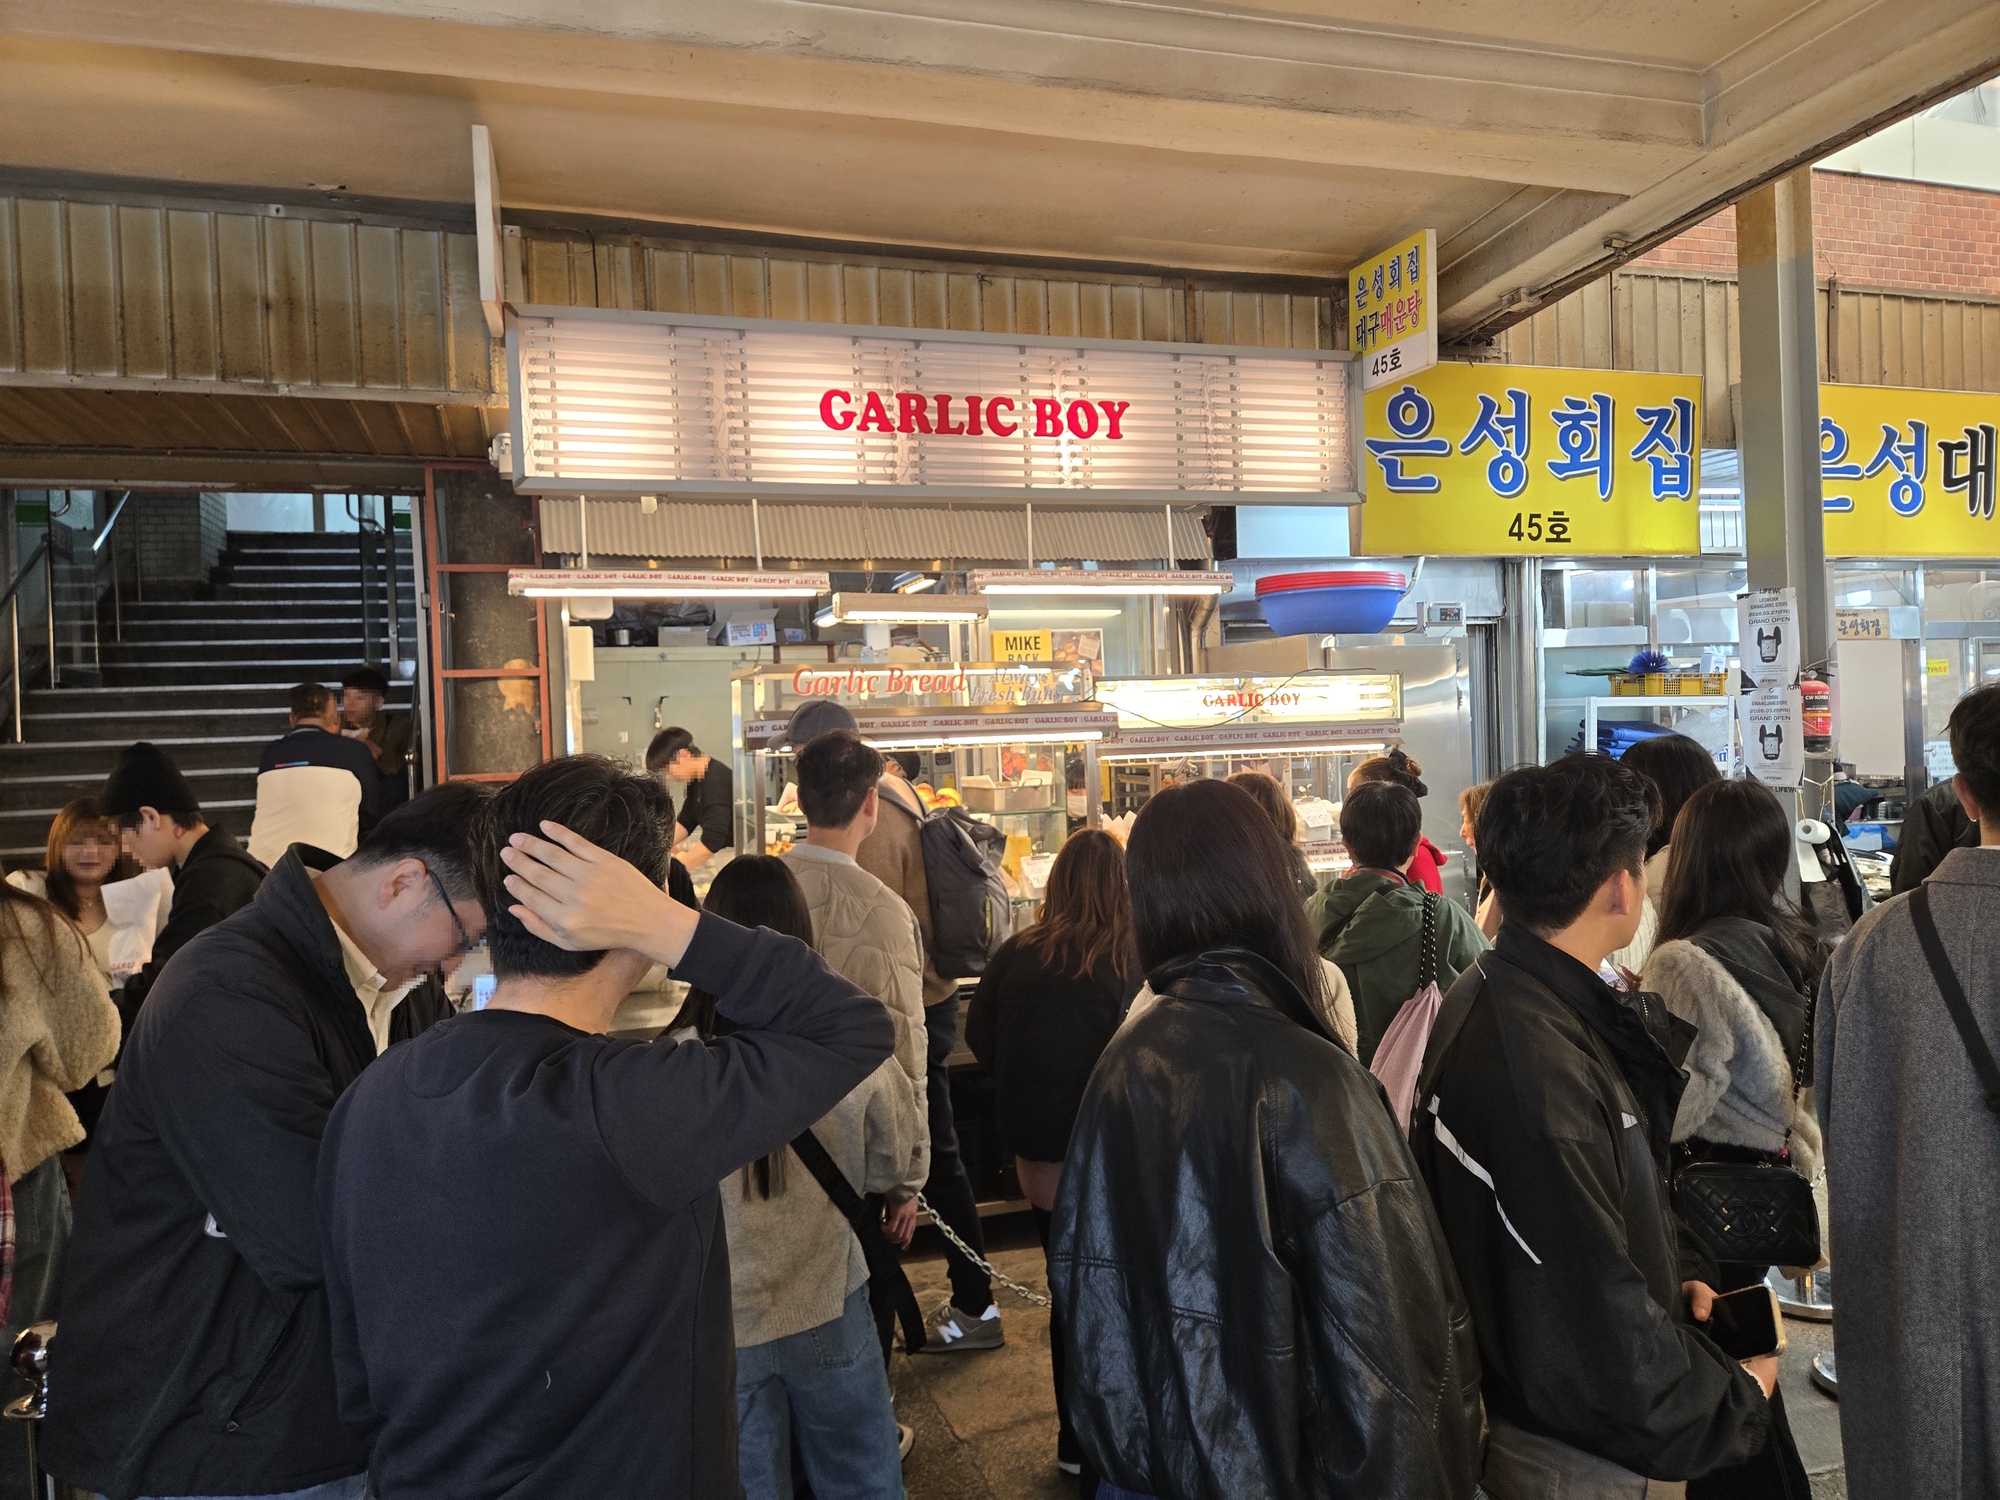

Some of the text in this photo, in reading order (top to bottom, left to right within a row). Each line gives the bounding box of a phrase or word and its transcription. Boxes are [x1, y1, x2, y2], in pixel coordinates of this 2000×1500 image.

[1355, 244, 1420, 310] 은성회집
[1355, 289, 1422, 350] 대구매운탕
[1372, 347, 1402, 377] 45호
[819, 389, 1130, 439] GARLIC BOY
[1365, 385, 1695, 501] 은성회집
[1508, 511, 1572, 543] 45호
[1005, 636, 1041, 651] MIKE
[793, 666, 967, 696] Garlic Bread
[970, 686, 1062, 701] Fresh Buns
[1203, 693, 1300, 707] GARLIC BOY
[881, 720, 910, 728] GARLIC
[964, 718, 979, 726] BOY
[1034, 716, 1062, 724] GARLIC
